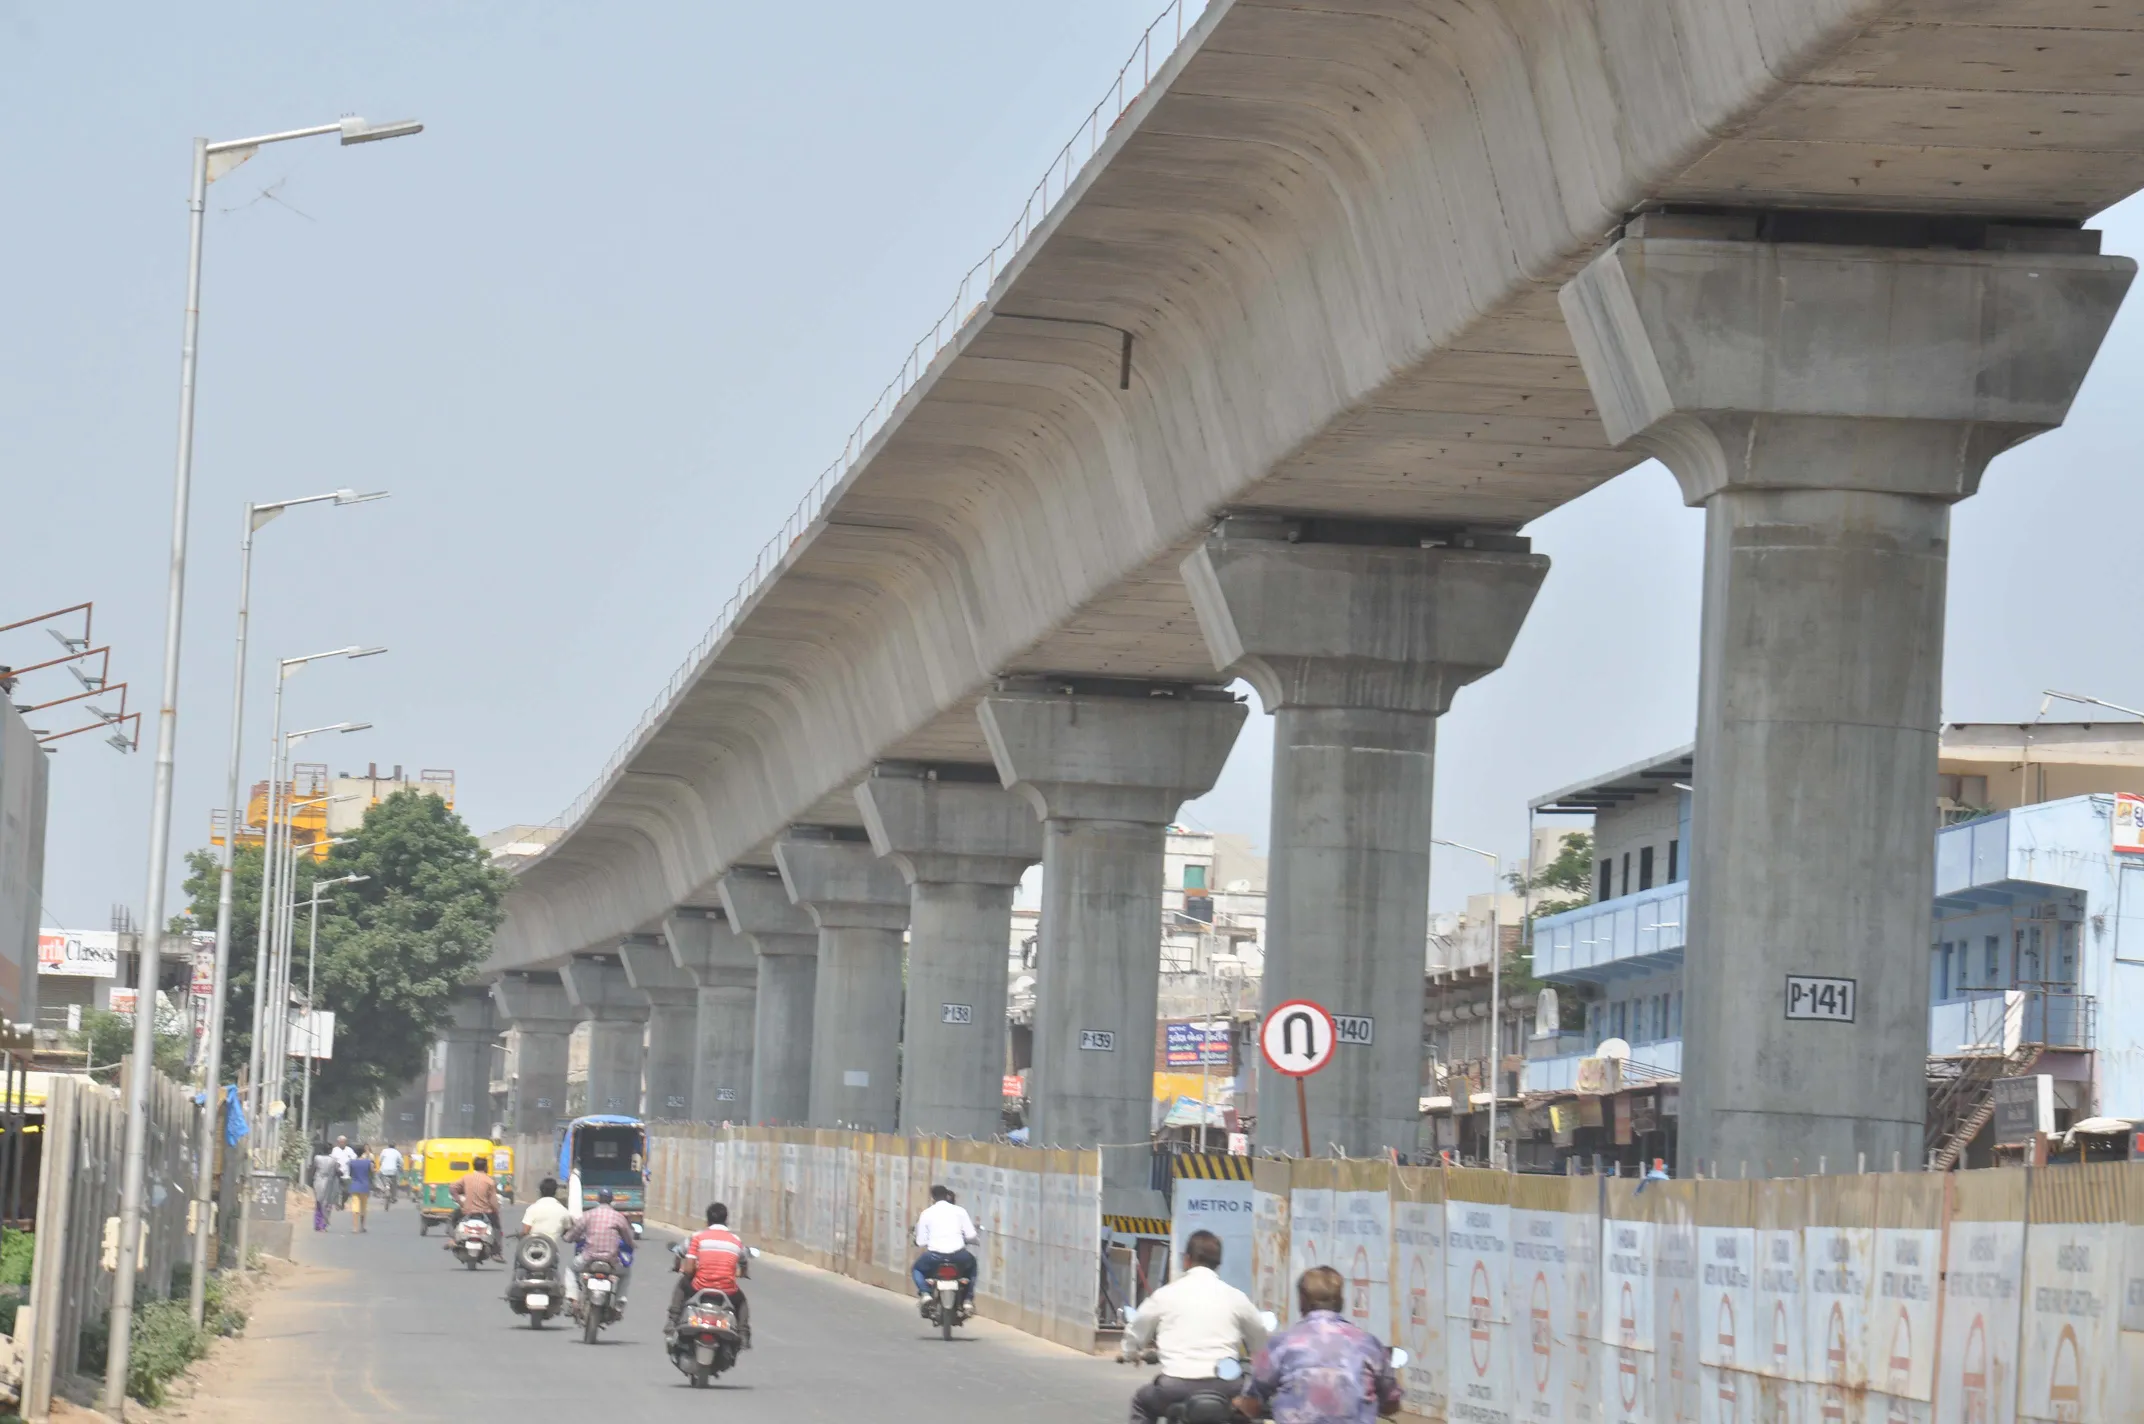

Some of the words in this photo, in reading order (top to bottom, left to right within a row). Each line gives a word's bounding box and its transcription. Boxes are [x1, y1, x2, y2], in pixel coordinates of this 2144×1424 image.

[66, 939, 117, 962] Classes
[1790, 982, 1847, 1015] P-141
[1083, 1033, 1111, 1048] P-139
[1187, 1199, 1240, 1212] METRO
